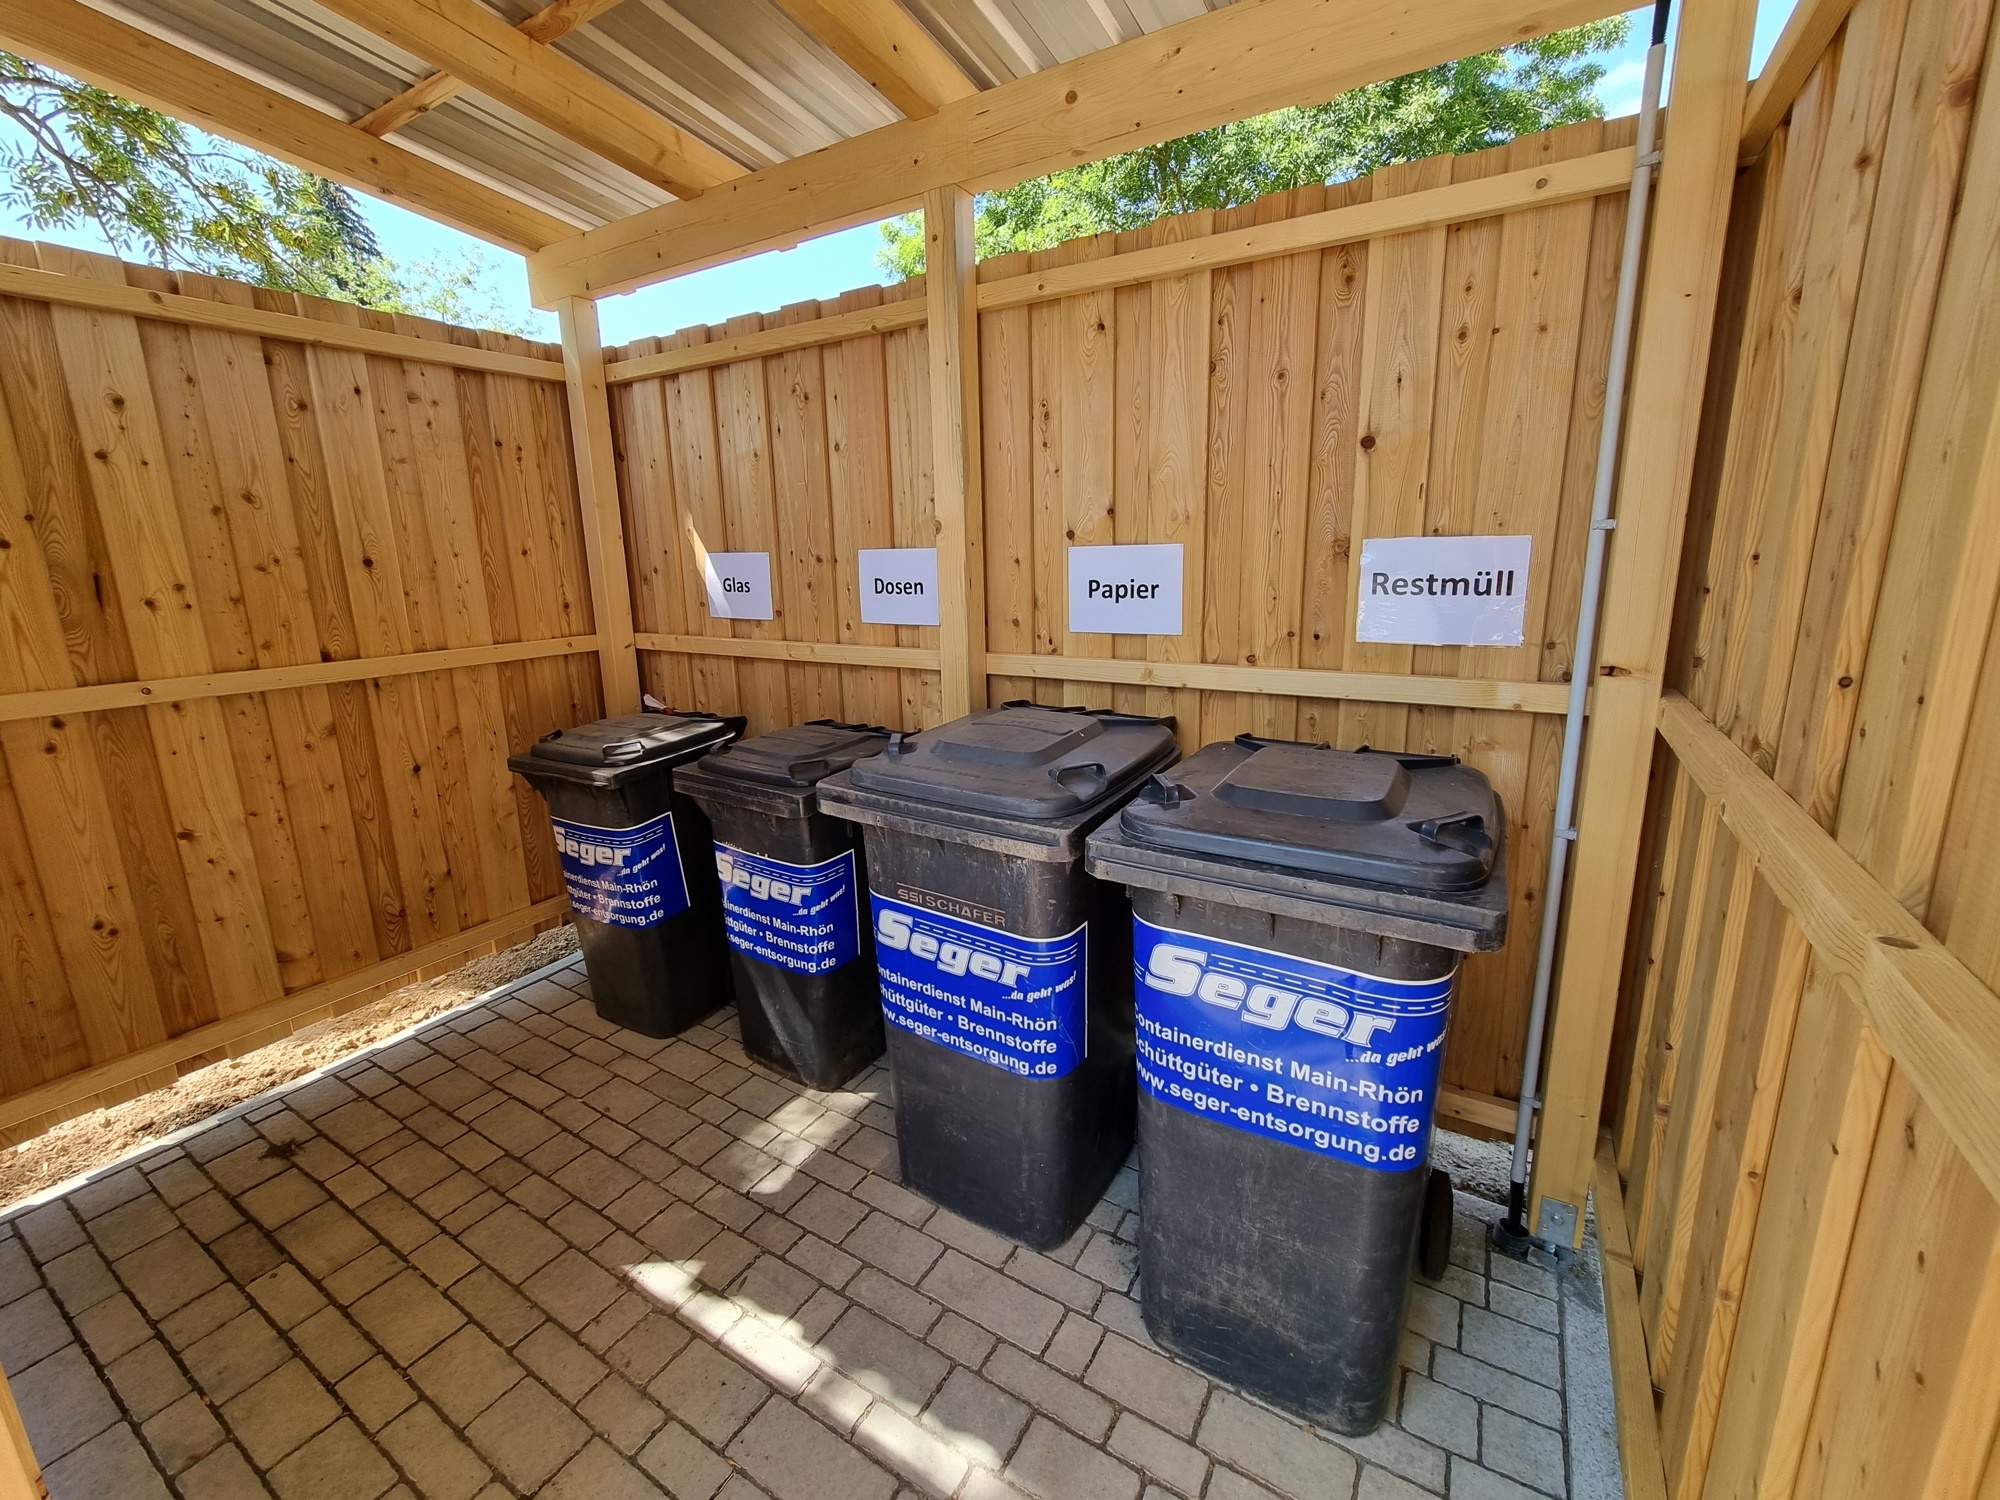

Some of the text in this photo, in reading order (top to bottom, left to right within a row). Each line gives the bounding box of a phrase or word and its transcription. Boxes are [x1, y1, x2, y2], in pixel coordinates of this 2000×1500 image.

[722, 576, 751, 593] Glas
[874, 577, 924, 595] Dosen
[1087, 578, 1160, 604] Papier
[1371, 569, 1515, 597] Restmüll
[600, 879, 658, 894] Main-Rhön
[715, 851, 813, 906] Seger
[597, 894, 661, 909] Brennstoffe
[810, 898, 829, 915] geht
[829, 884, 846, 902] was!
[897, 888, 923, 904] SSI
[569, 900, 665, 926] .seger-entsorgung.de
[721, 899, 834, 937] ainerdienst Main-Rhön
[726, 931, 837, 973] .seger-entsorgung.de
[765, 931, 835, 955] Brennstoffe
[877, 908, 1031, 988] Seger
[1026, 987, 1053, 1003] geht
[1055, 970, 1077, 993] was!
[1144, 943, 1397, 1048] Seger
[969, 998, 1057, 1032] Main-Rhön
[957, 1014, 1058, 1054] Brennstoffe
[1345, 1051, 1382, 1064] ...da
[1385, 1045, 1424, 1067] geht
[1290, 1061, 1424, 1106] Main-Rhön
[1266, 1082, 1420, 1134] Brennstoffe
